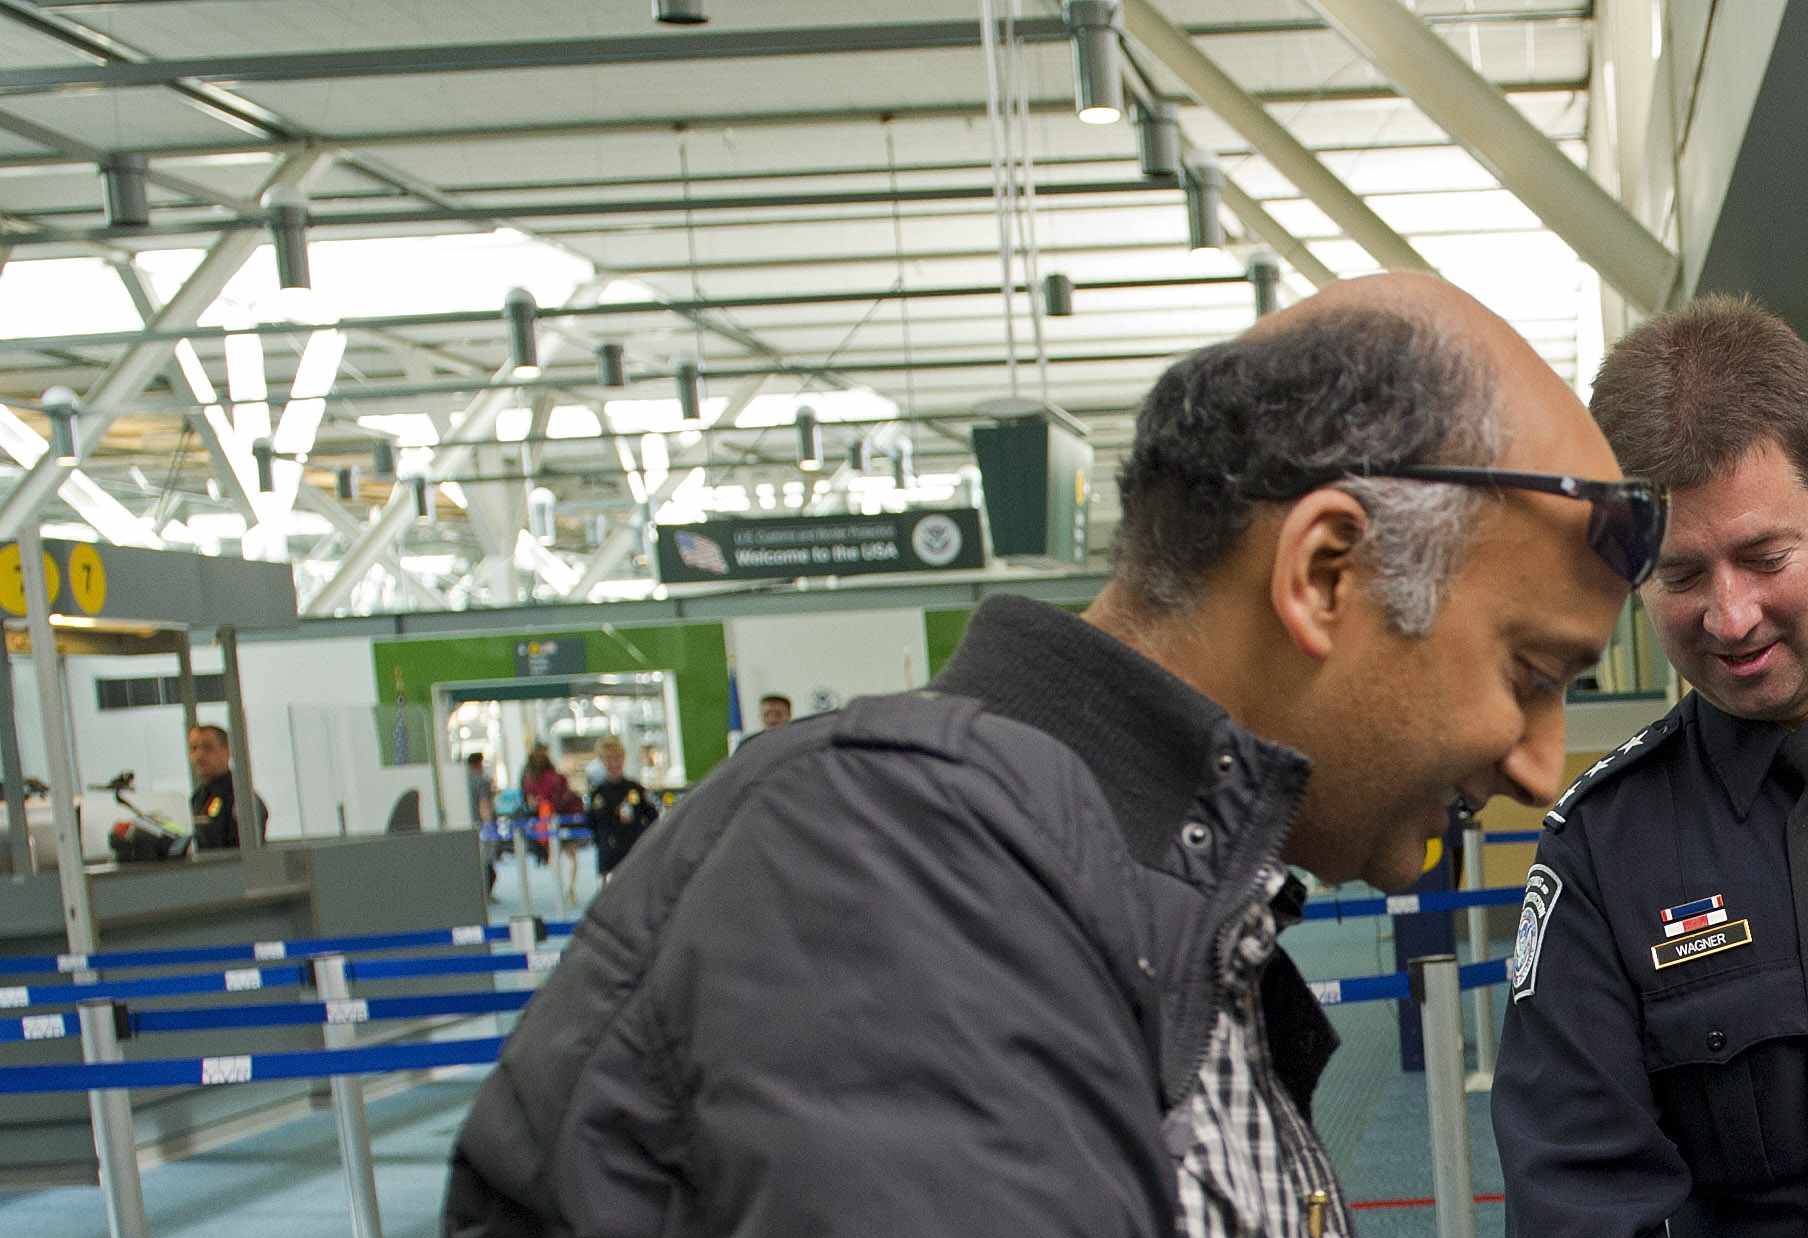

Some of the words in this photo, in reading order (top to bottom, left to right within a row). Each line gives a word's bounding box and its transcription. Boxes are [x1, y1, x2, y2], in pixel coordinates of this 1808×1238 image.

[734, 547, 810, 567] Welcome
[812, 546, 830, 562] to
[832, 543, 860, 562] the
[862, 541, 899, 561] USA
[1675, 933, 1727, 957] WAGNER
